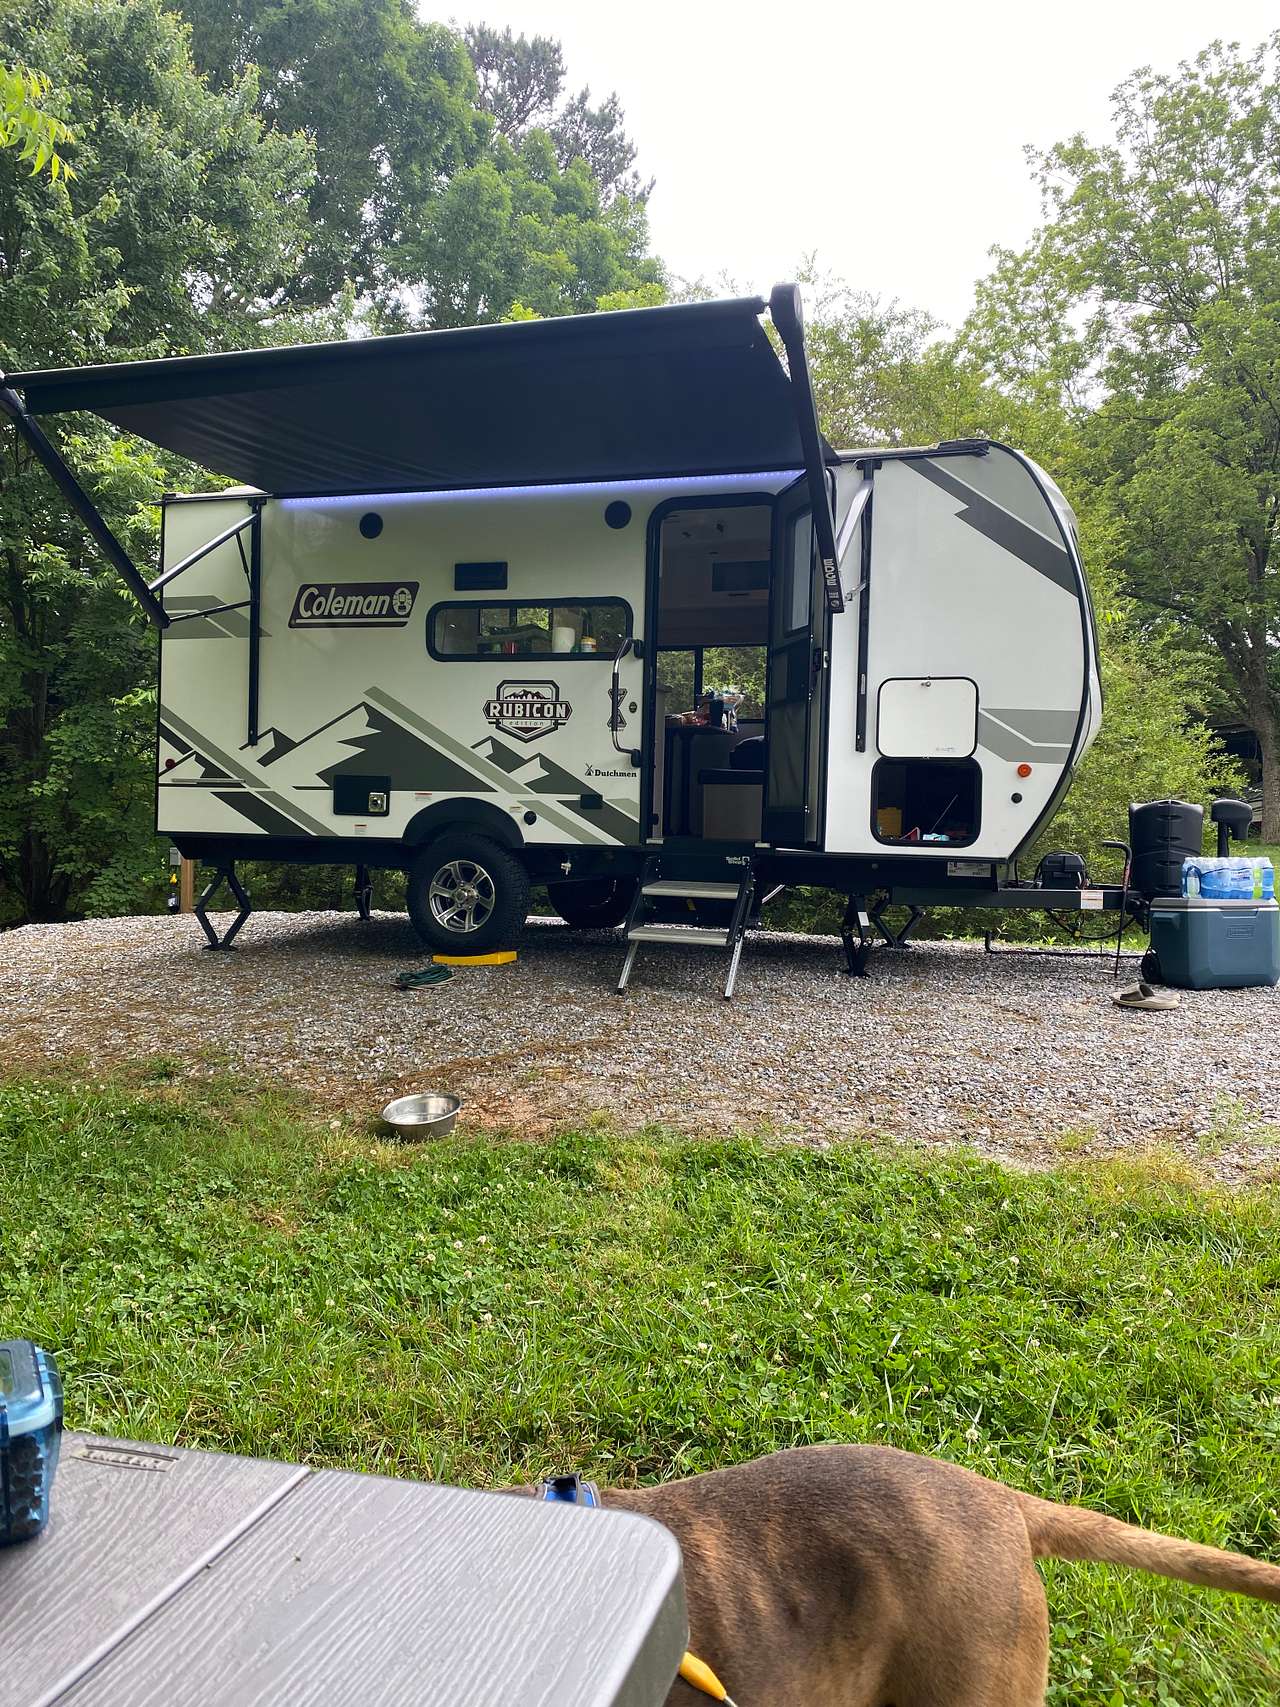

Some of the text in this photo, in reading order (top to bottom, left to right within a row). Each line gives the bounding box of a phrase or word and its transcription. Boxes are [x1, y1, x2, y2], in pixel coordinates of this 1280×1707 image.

[823, 558, 837, 586] EDGE
[299, 586, 391, 618] Coleman
[489, 702, 567, 718] RUBICON
[594, 769, 638, 778] Dutchmen
